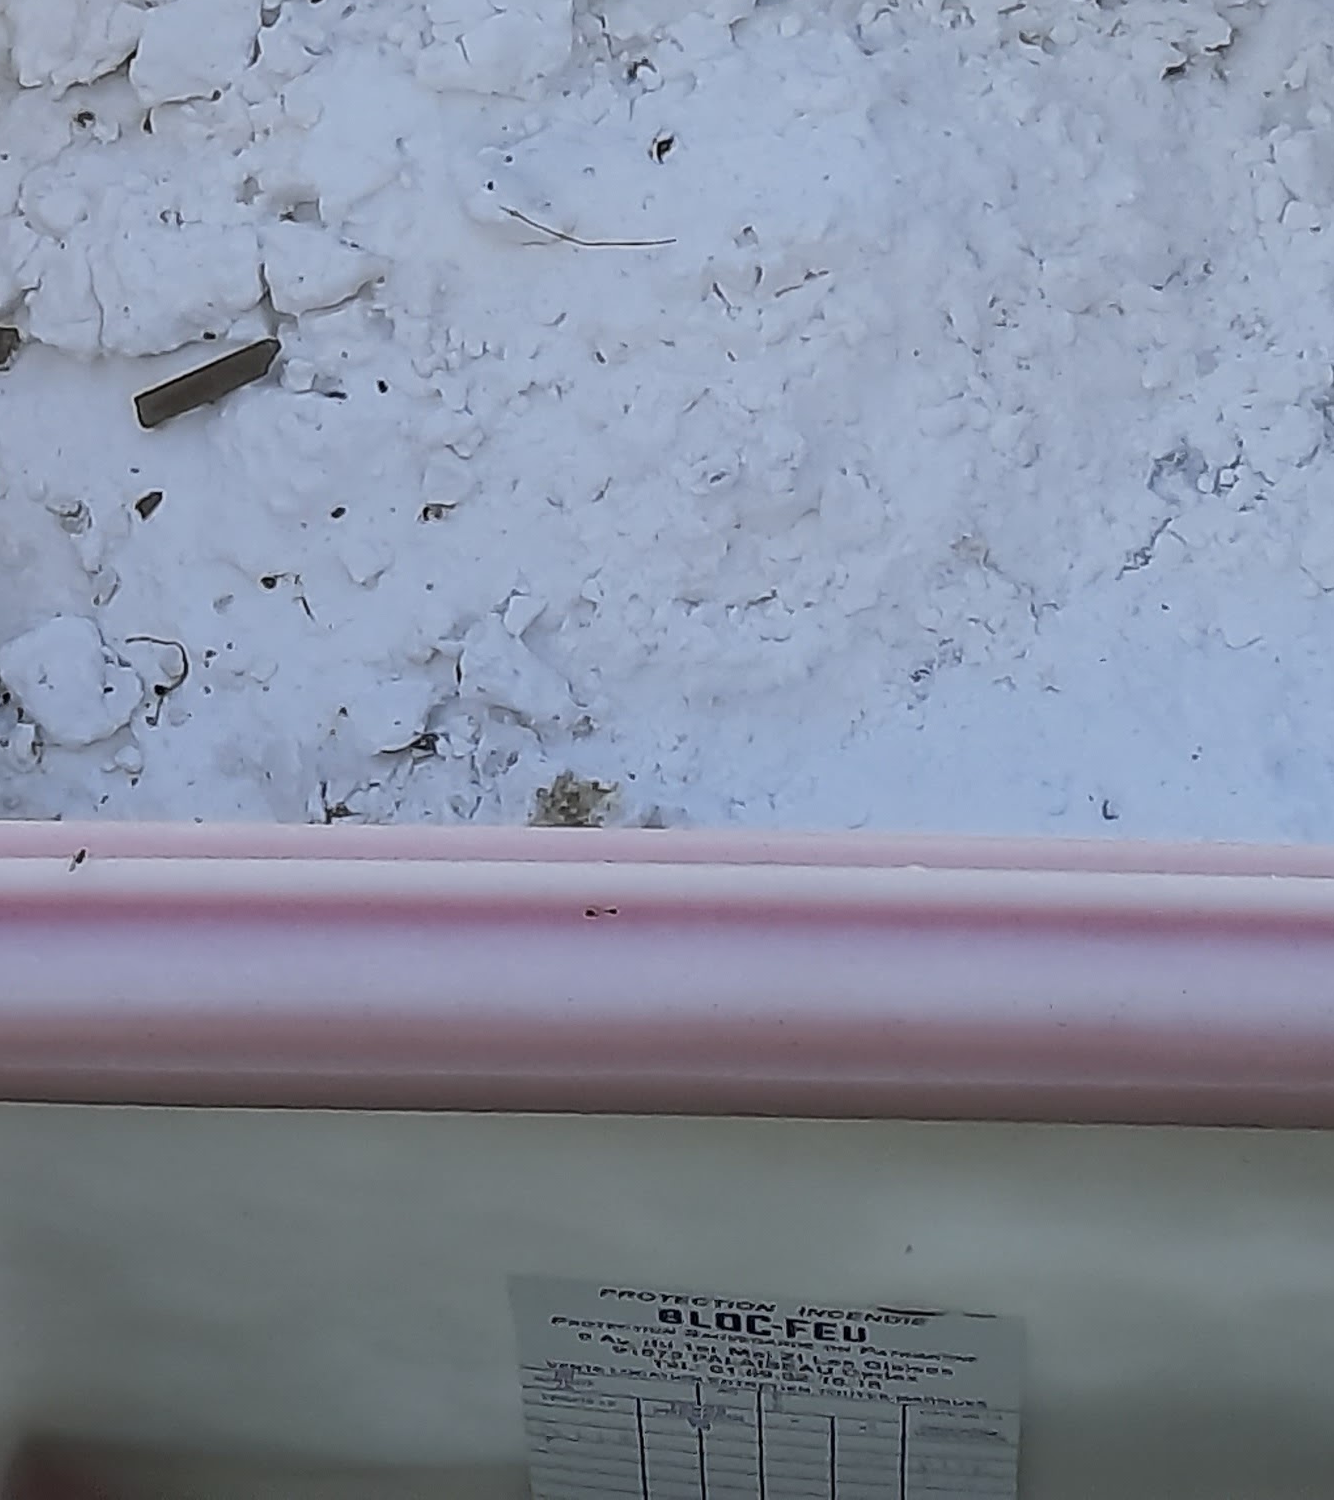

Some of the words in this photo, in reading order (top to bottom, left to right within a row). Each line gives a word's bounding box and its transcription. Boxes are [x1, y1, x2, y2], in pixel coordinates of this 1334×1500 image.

[600, 1287, 777, 1313] PROTECTION
[798, 1305, 928, 1327] INCENDIE
[658, 1308, 867, 1343] BLOC-FEU
